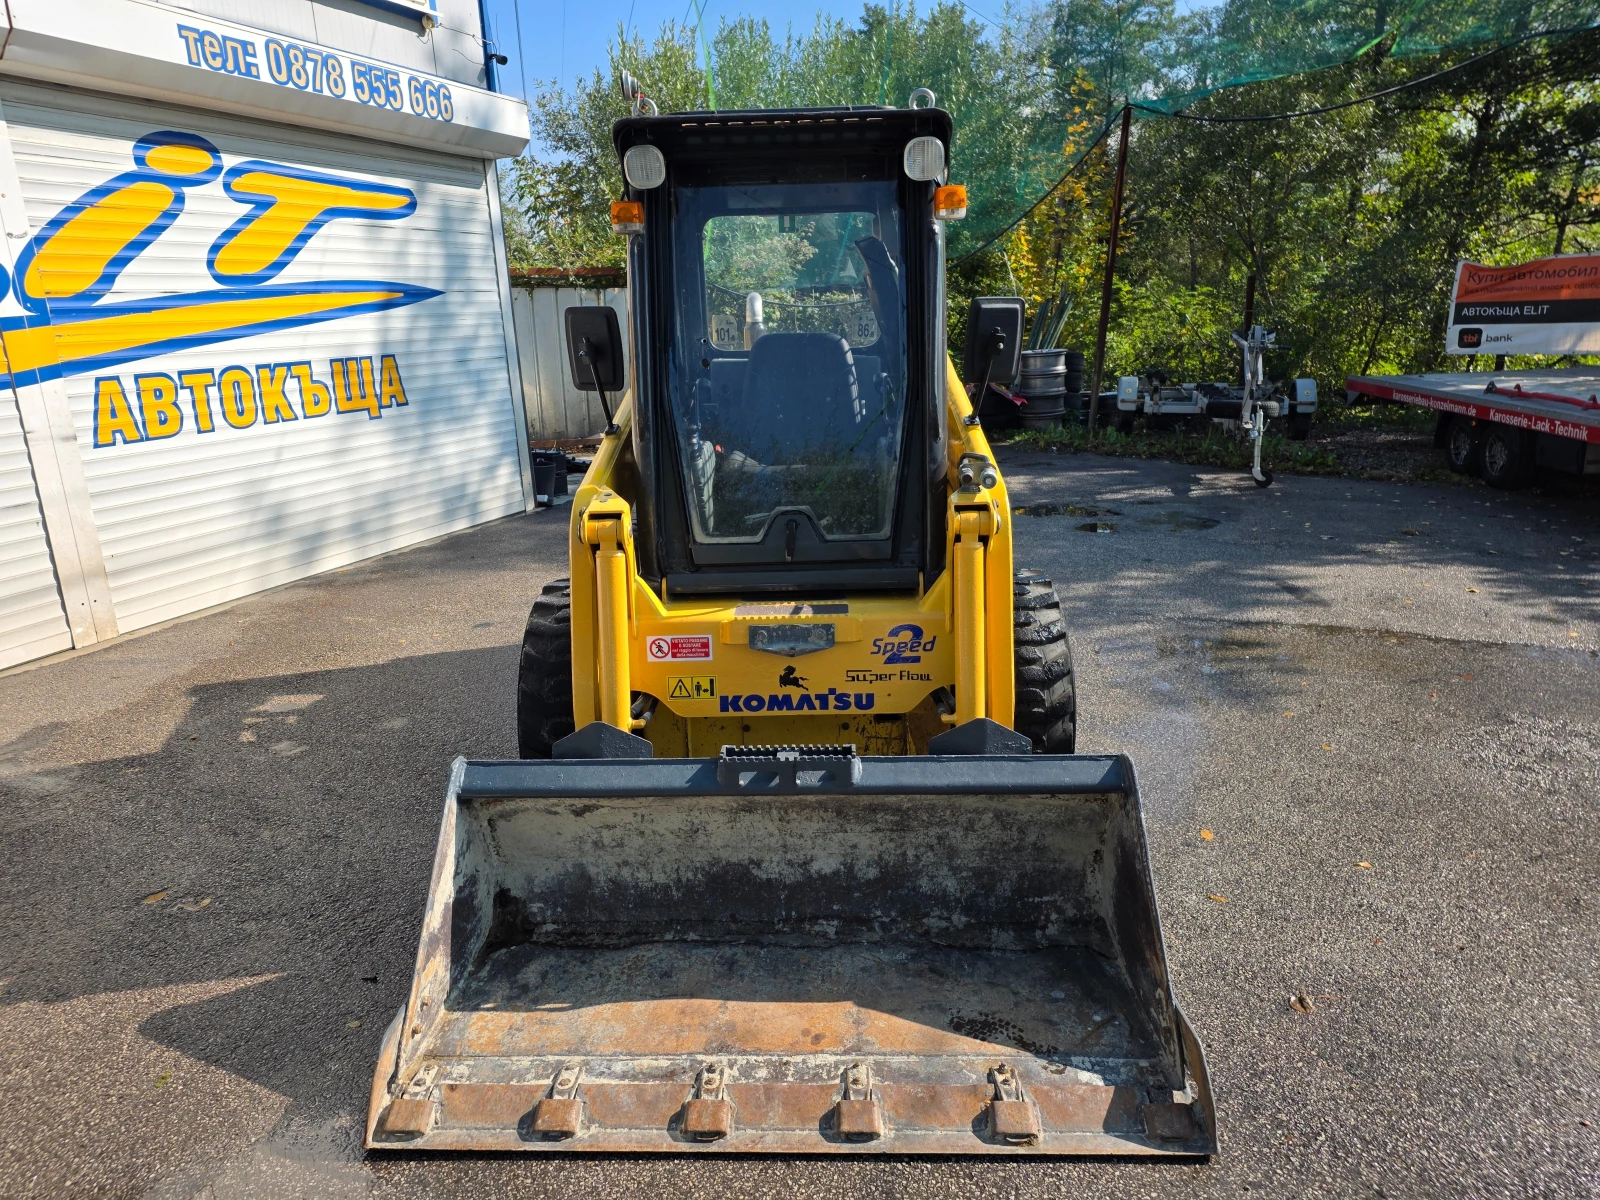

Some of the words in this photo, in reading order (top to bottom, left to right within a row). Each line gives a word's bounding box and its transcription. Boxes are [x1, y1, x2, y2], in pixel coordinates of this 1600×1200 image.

[177, 23, 260, 80] тел:
[264, 38, 346, 99] 0878
[350, 60, 403, 111] 555
[408, 76, 454, 122] 666
[1467, 271, 1503, 285] Купи
[1508, 265, 1598, 281] автомобил
[1462, 306, 1521, 317] АВТОКЪЩА
[1523, 305, 1550, 315] ELIT
[715, 327, 730, 342] 101
[857, 323, 870, 338] 86
[1463, 334, 1478, 343] tbi
[1486, 333, 1513, 343] bank
[93, 354, 408, 449] АВТОКЪЩА
[1392, 389, 1477, 417] karosseriebau-konzelmann.de
[870, 635, 938, 656] Speed
[883, 623, 924, 665] 2
[845, 669, 898, 684] Super
[900, 670, 932, 681] Flow
[719, 688, 875, 713] KOMATSU
